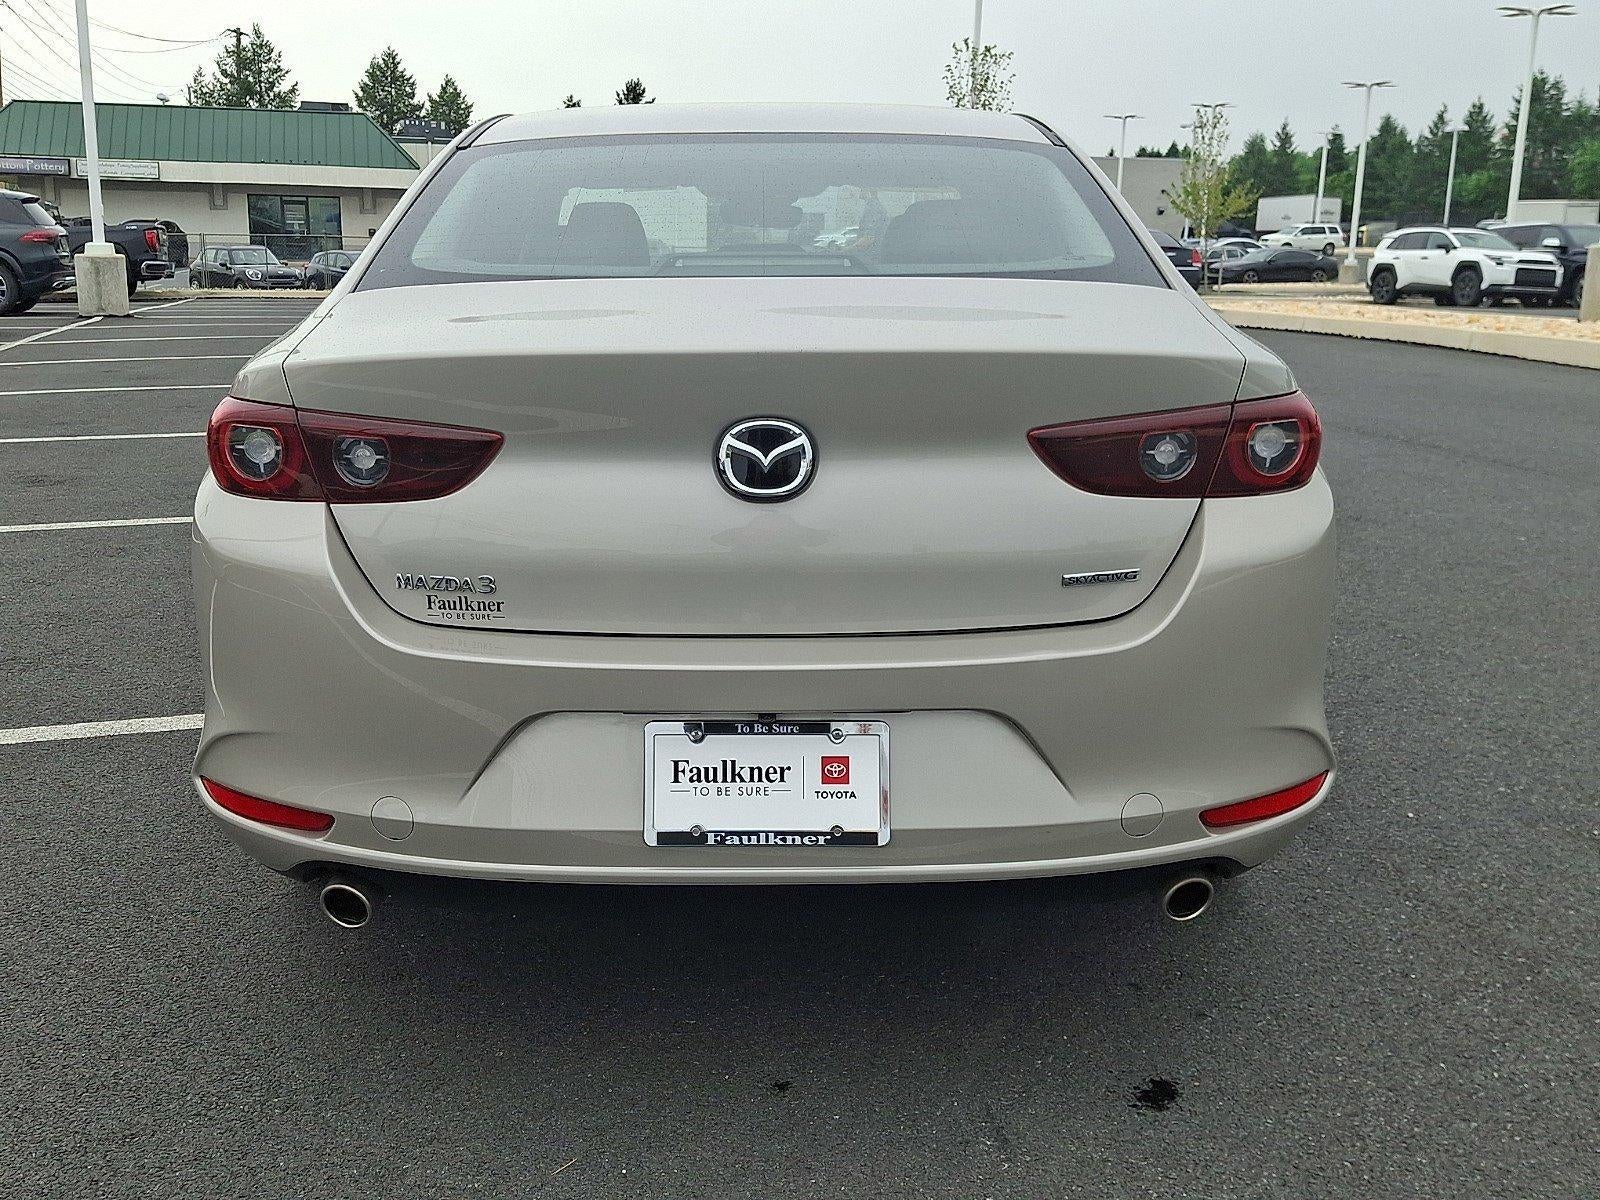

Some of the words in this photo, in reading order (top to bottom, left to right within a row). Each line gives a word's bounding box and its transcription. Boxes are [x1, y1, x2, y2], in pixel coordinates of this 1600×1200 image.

[0, 161, 24, 170] ttom
[26, 159, 65, 175] Pottery
[426, 594, 505, 612] Faulkner
[441, 612, 453, 620] TO
[470, 613, 492, 621] SURE
[735, 723, 749, 734] To
[754, 723, 769, 734] Be
[772, 723, 800, 734] Sure
[670, 759, 792, 784] Faulkner
[692, 786, 710, 797] TO
[716, 786, 731, 797] BE
[737, 786, 770, 797] SURE
[814, 790, 857, 800] TOYOTA
[705, 832, 832, 846] Faulkner
